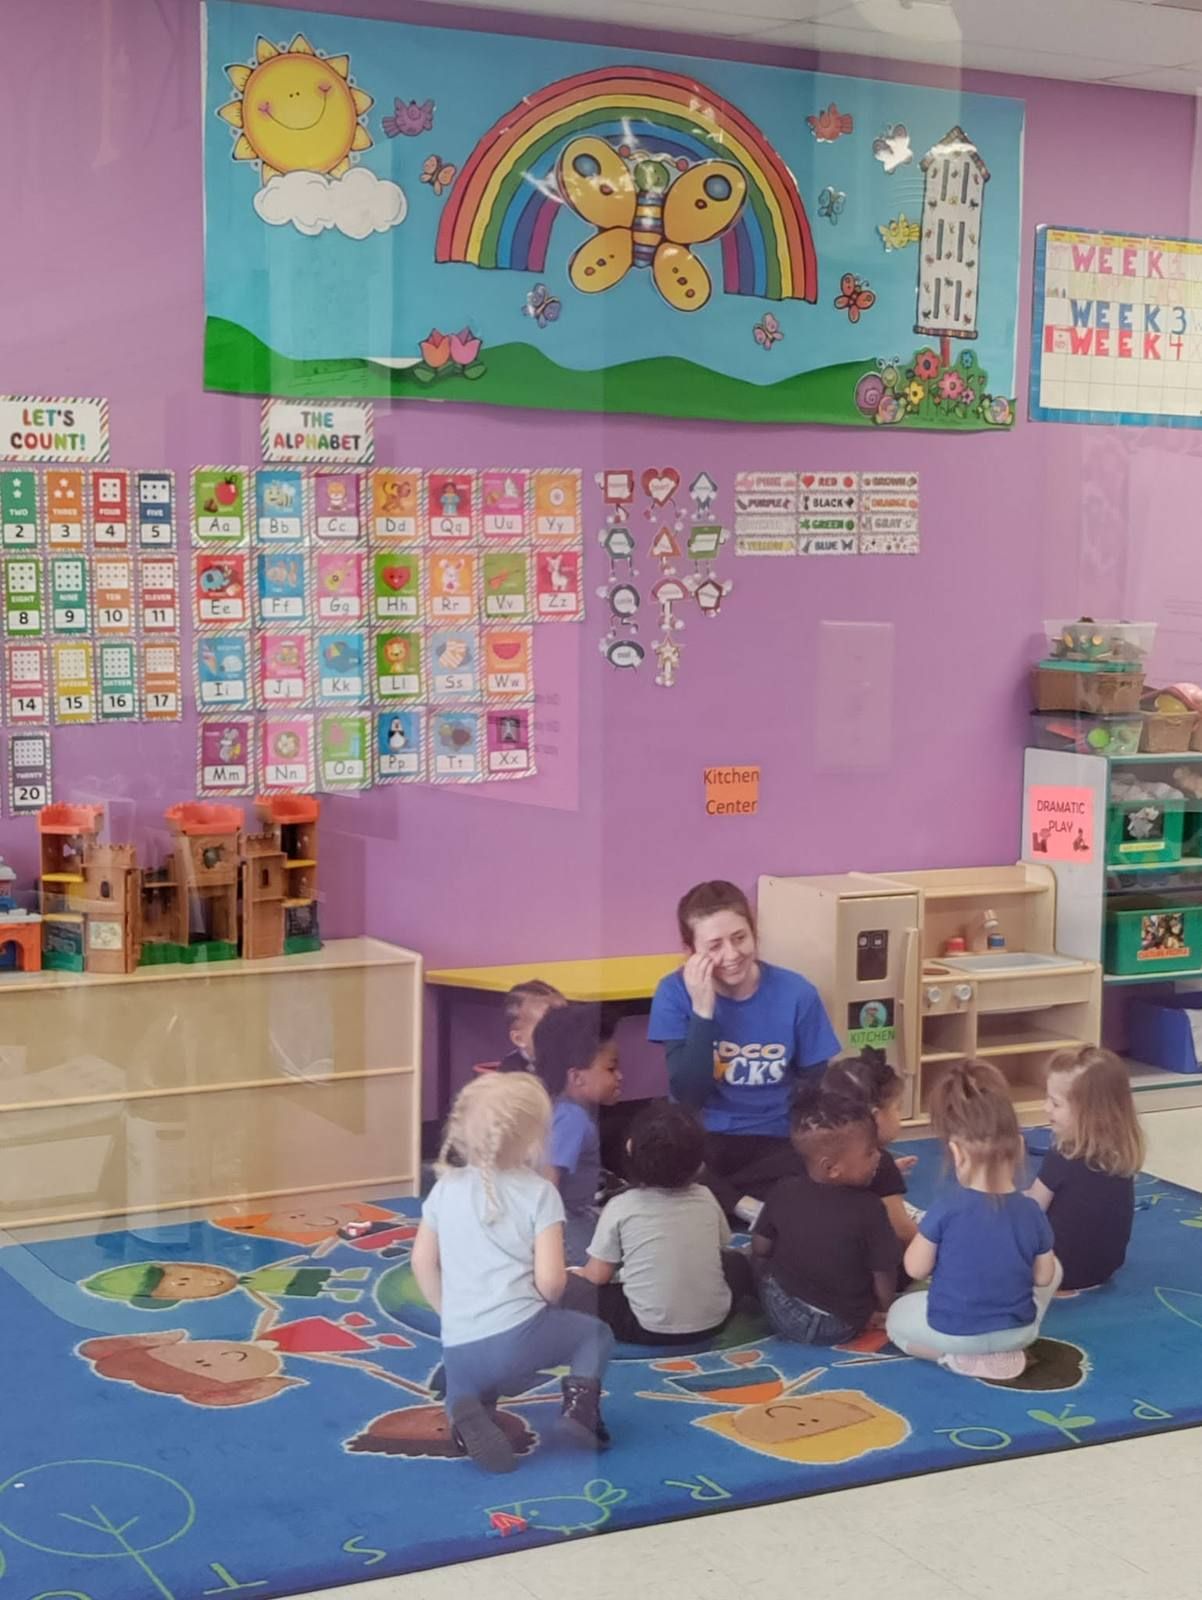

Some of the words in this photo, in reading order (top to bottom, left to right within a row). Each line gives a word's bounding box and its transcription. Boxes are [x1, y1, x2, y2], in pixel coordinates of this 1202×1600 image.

[1072, 244, 1164, 279] WEEK
[1071, 299, 1162, 333] WEEK
[1171, 306, 1187, 335] 3
[1071, 326, 1161, 360] WEEK
[1169, 334, 1184, 360] 4
[22, 408, 75, 427] LET'S
[300, 411, 334, 428] THE
[10, 432, 86, 451] COUNT!
[273, 433, 361, 451] ALPHABET
[813, 498, 843, 508] BLACK
[15, 524, 24, 538] 2
[61, 524, 70, 538] 3
[105, 524, 115, 538] 4
[151, 524, 160, 538] 5
[209, 518, 230, 532] Aa
[270, 519, 289, 534] Bb
[385, 518, 406, 533] Dd
[814, 539, 838, 550] BLUE
[210, 599, 231, 615] Ee
[272, 598, 289, 612] Ff
[386, 597, 407, 611] Hh
[19, 611, 29, 625] 8
[64, 610, 75, 623] 9
[105, 609, 123, 622] 10
[151, 609, 166, 622] 11
[332, 679, 350, 692] Kk
[18, 698, 36, 711] 14
[66, 696, 82, 709] 15
[109, 694, 126, 707] 16
[153, 694, 169, 707] 17
[388, 755, 406, 770] Pp
[212, 767, 240, 781] Mm
[275, 766, 298, 780] Nn
[704, 768, 760, 784] Kitchen
[20, 787, 40, 800] 20
[706, 800, 758, 815] Center
[1036, 799, 1086, 814] DRAMATIC
[1048, 820, 1074, 833] PLAY
[850, 1029, 896, 1044] KITCHEN
[664, 1475, 733, 1502] R
